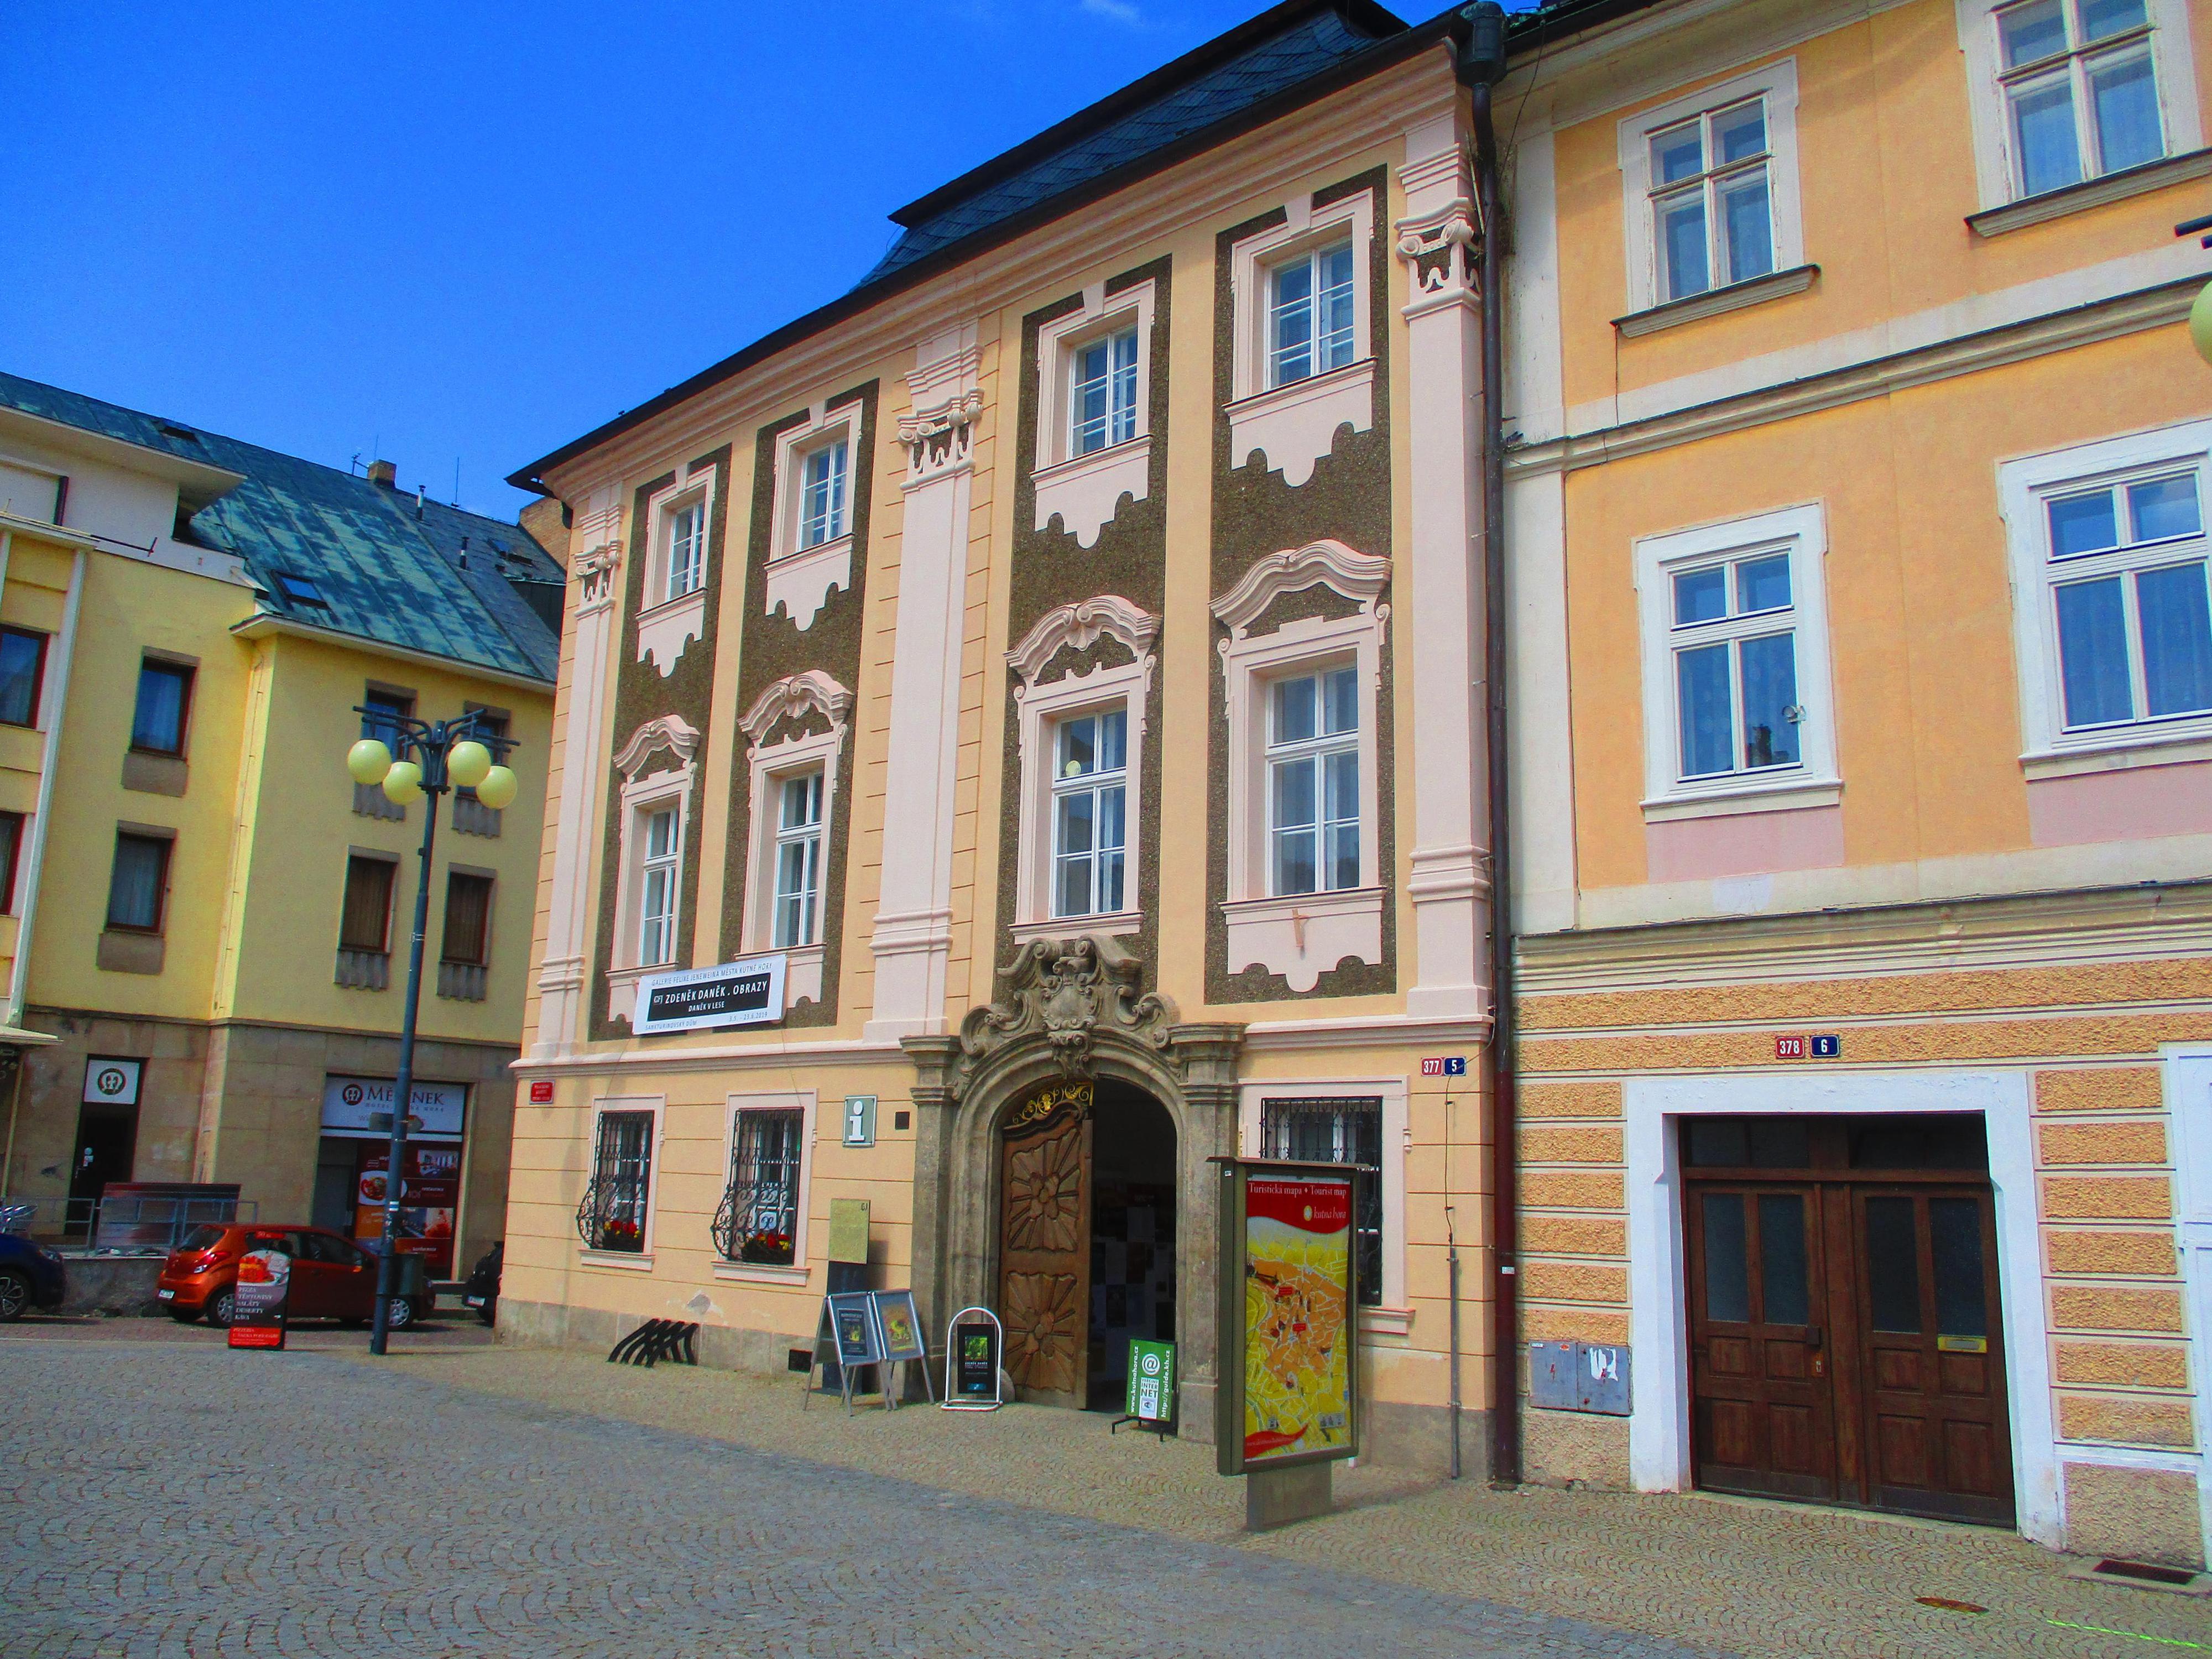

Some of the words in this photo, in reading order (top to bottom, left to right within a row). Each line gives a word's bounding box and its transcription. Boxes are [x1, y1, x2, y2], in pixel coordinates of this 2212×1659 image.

[652, 977, 672, 986] GALERIE
[721, 967, 738, 977] MĚSTA
[758, 962, 773, 972] HORY
[665, 989, 697, 1004] ZDENĚK
[698, 985, 726, 1000] DANĚK
[733, 980, 768, 995] OBRAZY
[688, 1002, 707, 1012] DANĚK
[712, 1001, 725, 1009] LESE
[743, 1011, 768, 1020] 23.6.2019
[686, 1019, 697, 1027] DŮM
[1780, 1040, 1799, 1054] 378
[1821, 1039, 1828, 1053] 6
[1424, 1061, 1439, 1073] 377
[1452, 1060, 1457, 1072] 5
[1249, 1183, 1282, 1194] Turistická
[1284, 1187, 1302, 1198] mapa
[1310, 1185, 1333, 1196] Tourist
[1334, 1189, 1347, 1199] map
[1130, 1346, 1139, 1412] www.kutnahora.cz
[1161, 1350, 1170, 1417] http://guide.kh.cz
[1141, 1389, 1158, 1398] NET
